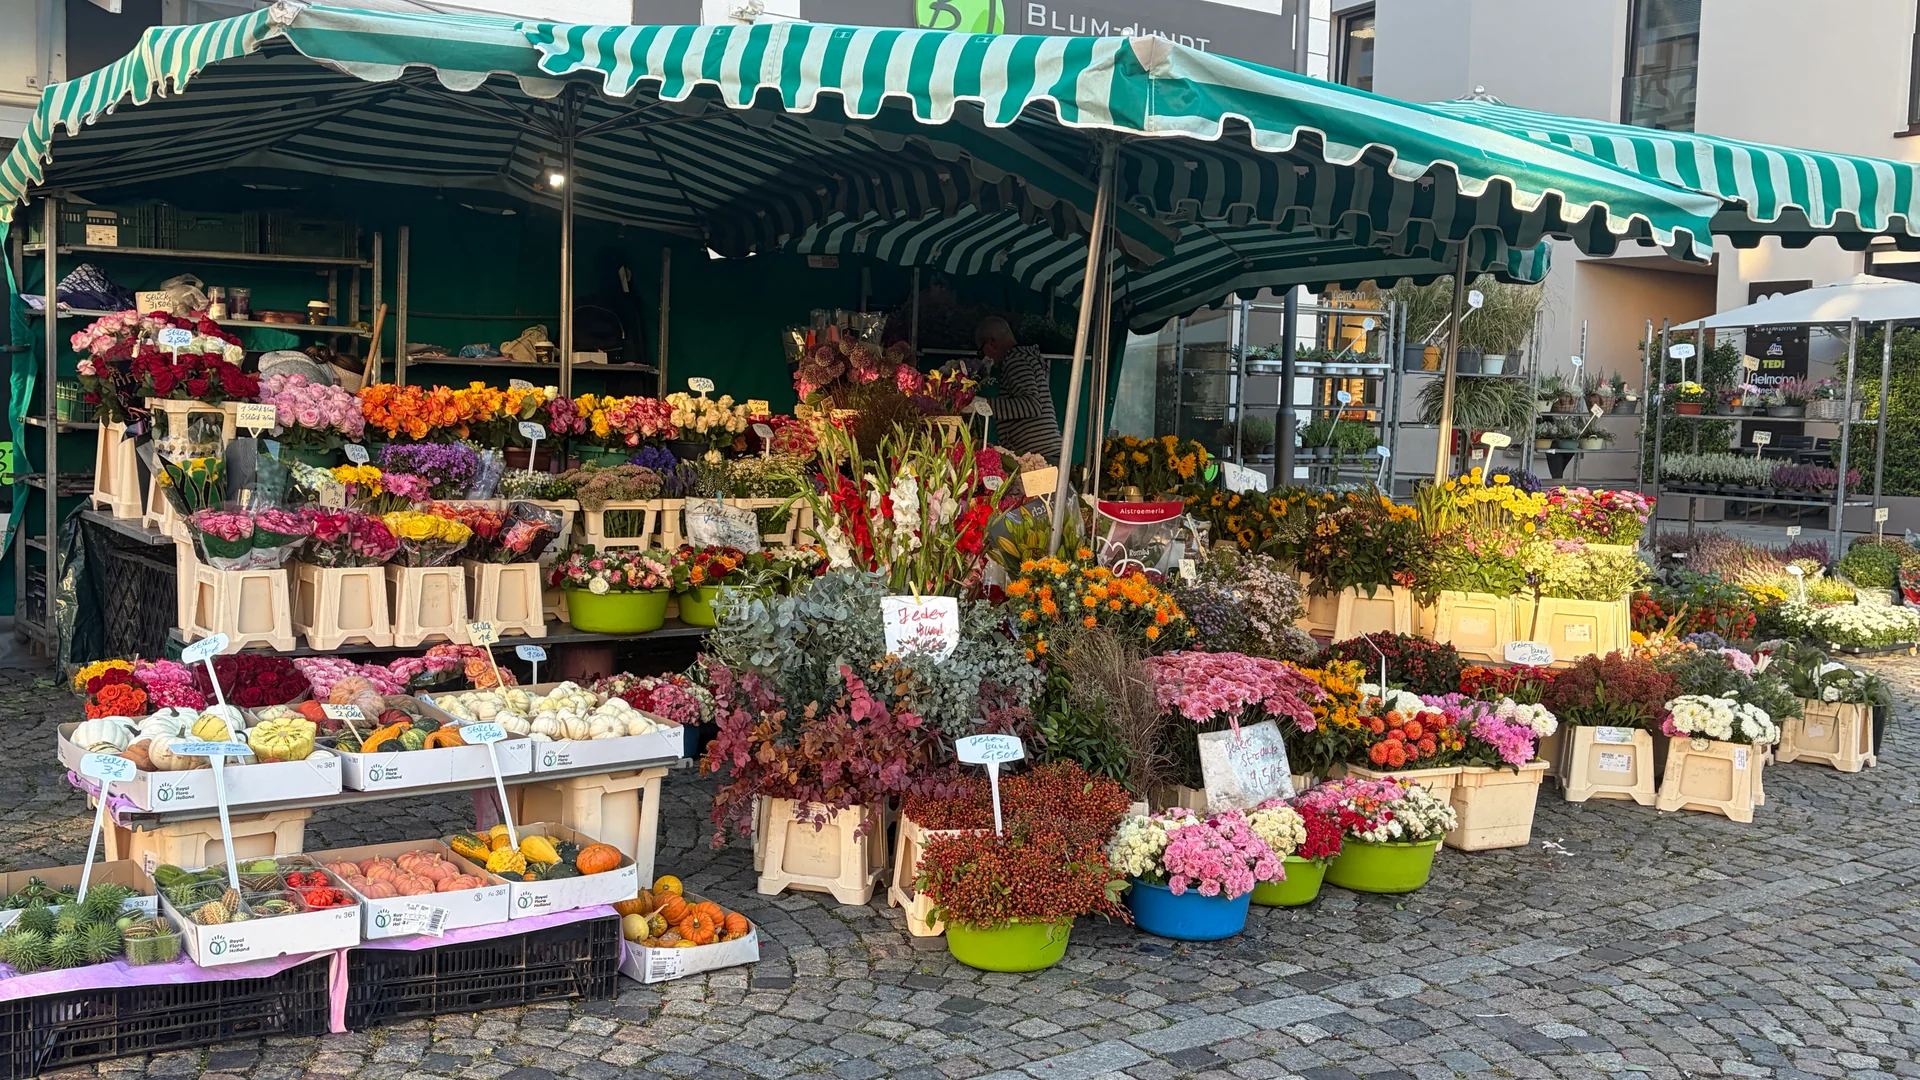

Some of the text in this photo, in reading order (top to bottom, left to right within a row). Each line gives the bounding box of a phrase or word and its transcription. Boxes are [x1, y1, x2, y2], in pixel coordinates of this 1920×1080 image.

[1762, 359, 1786, 369] TEDi
[1750, 373, 1795, 385] Fielmann
[1119, 507, 1165, 515] Alstroemeria
[898, 607, 948, 625] Jeder
[191, 637, 219, 652] Stück
[467, 723, 496, 734] Stück
[985, 742, 1010, 750] Bund
[94, 755, 129, 769] Stück
[134, 900, 149, 908] 337
[343, 910, 356, 919] 361
